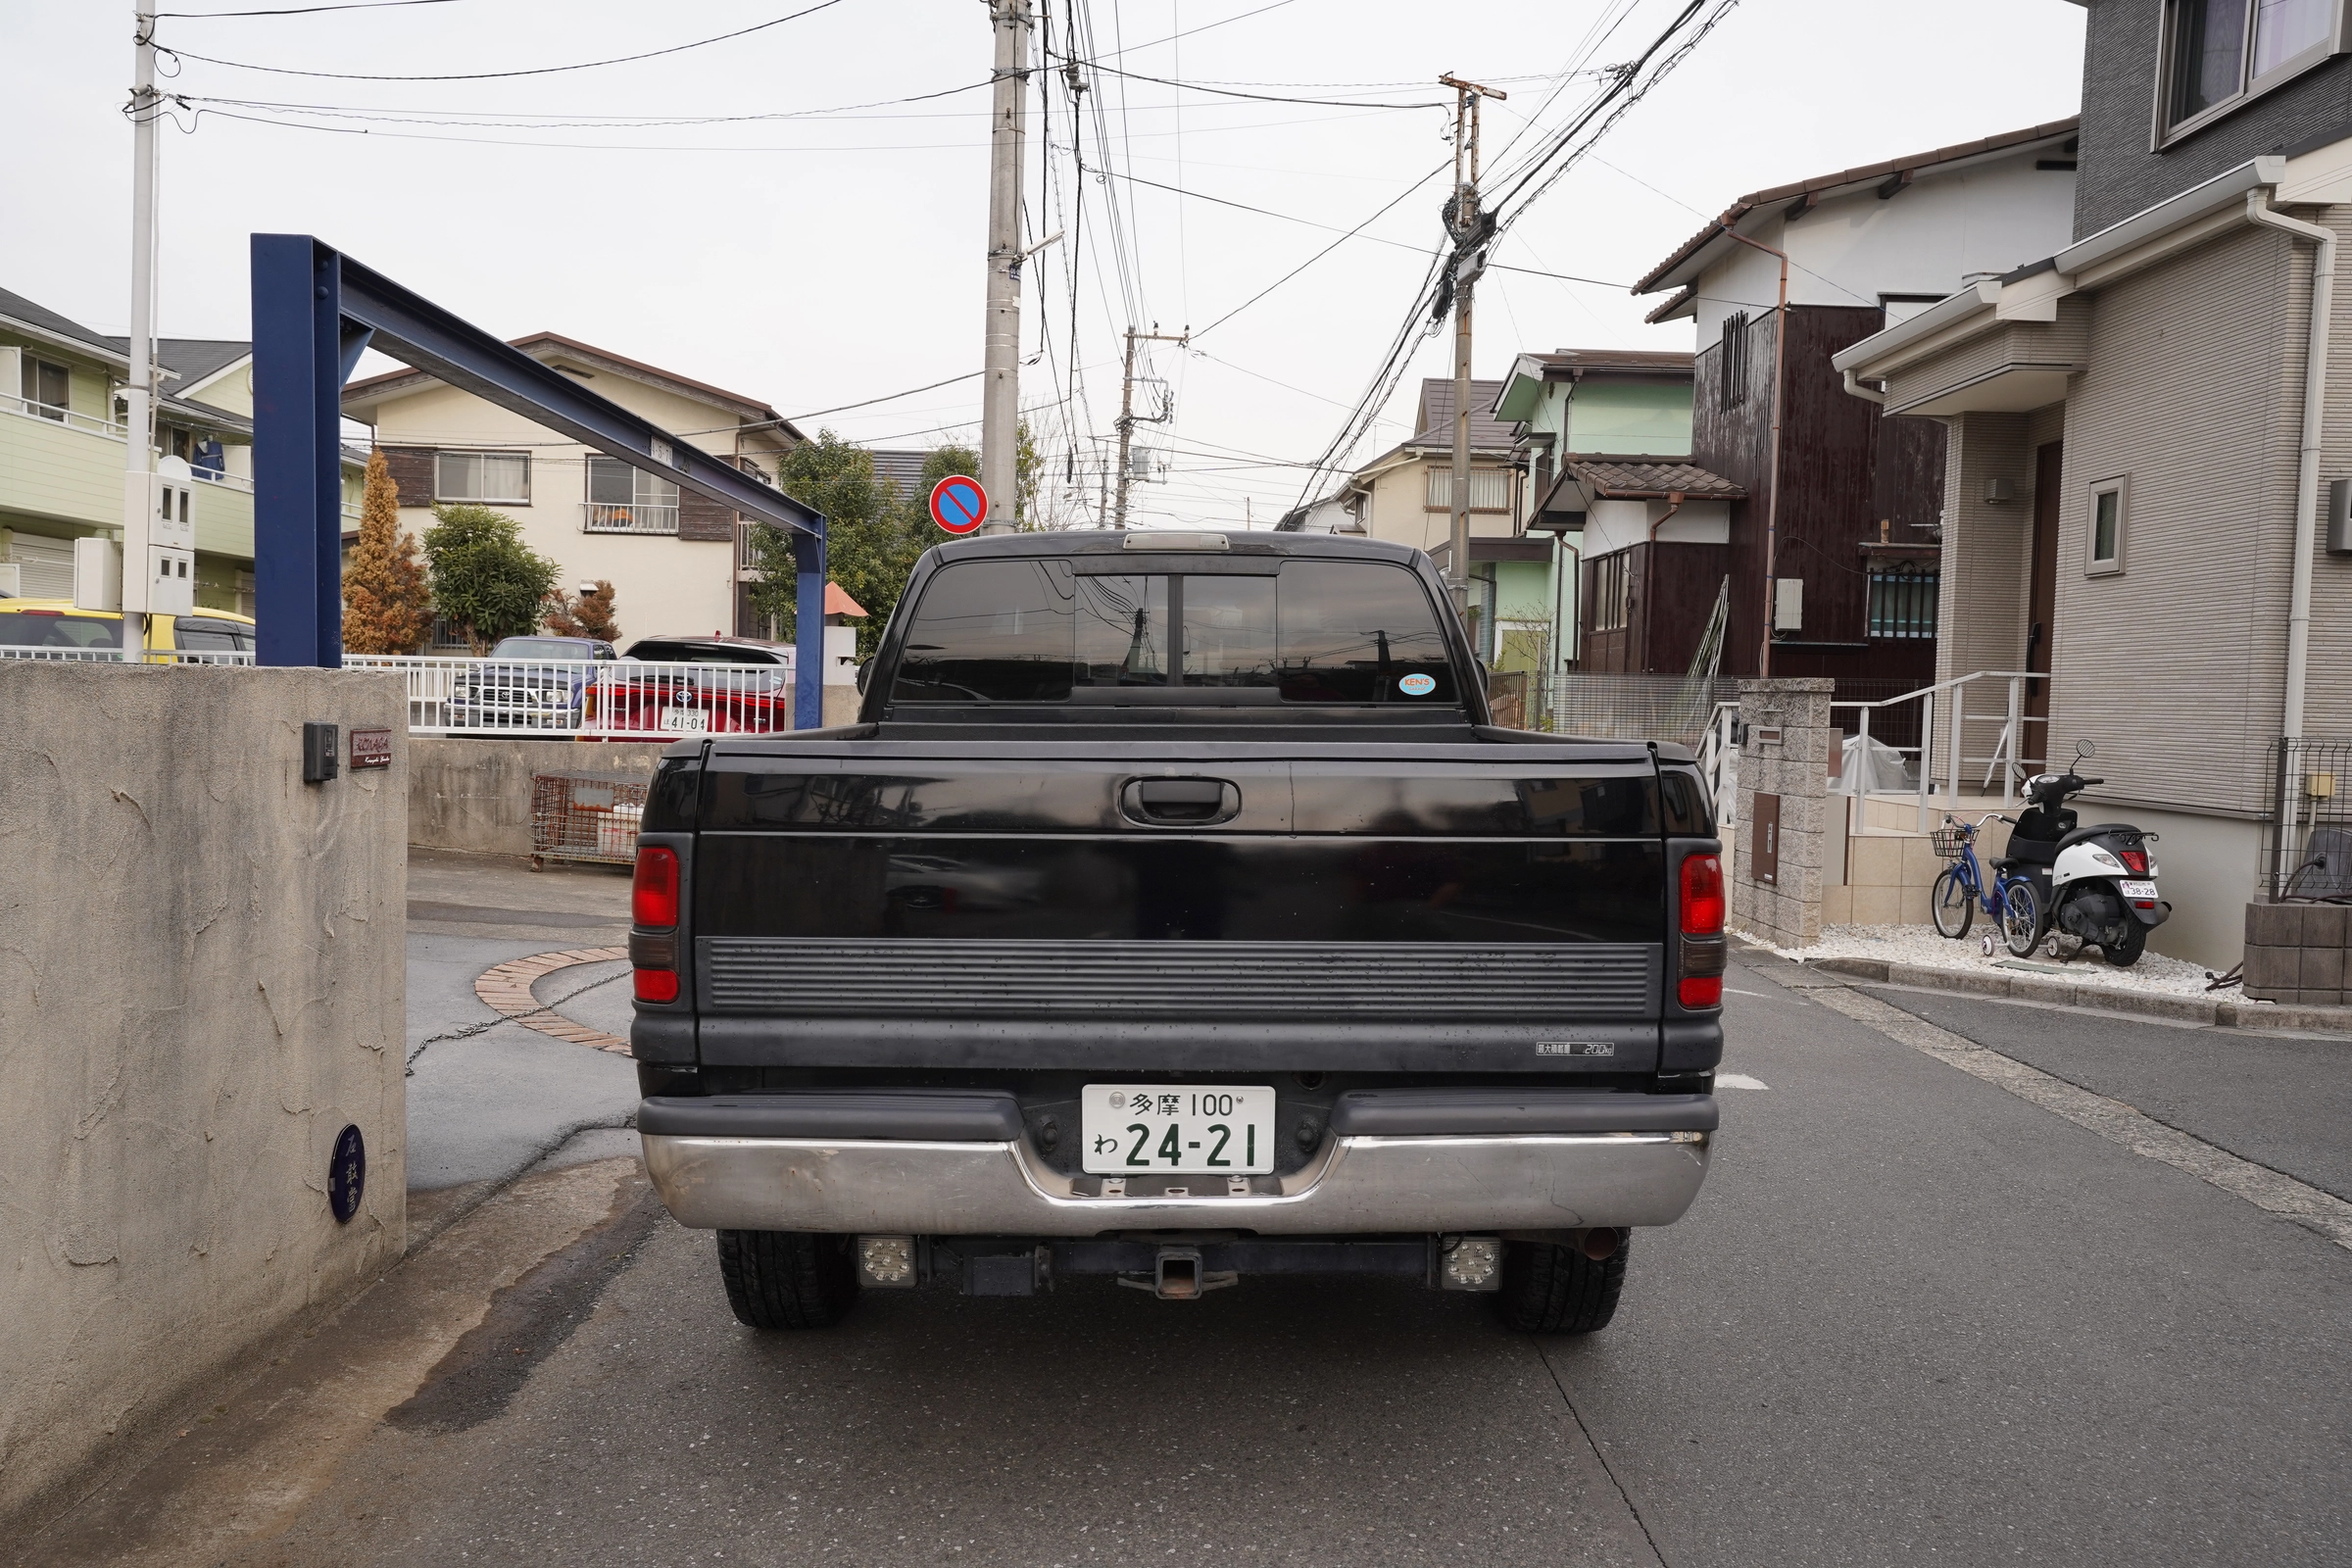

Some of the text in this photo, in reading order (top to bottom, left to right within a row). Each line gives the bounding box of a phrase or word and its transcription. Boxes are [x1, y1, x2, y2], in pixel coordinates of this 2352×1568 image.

[1404, 677, 1430, 687] KEN'S
[671, 716, 705, 730] 41-04
[2130, 887, 2155, 896] 38-28
[1129, 1093, 1233, 1116] 多摩 100
[1094, 1123, 1255, 1166] わ 24-21
